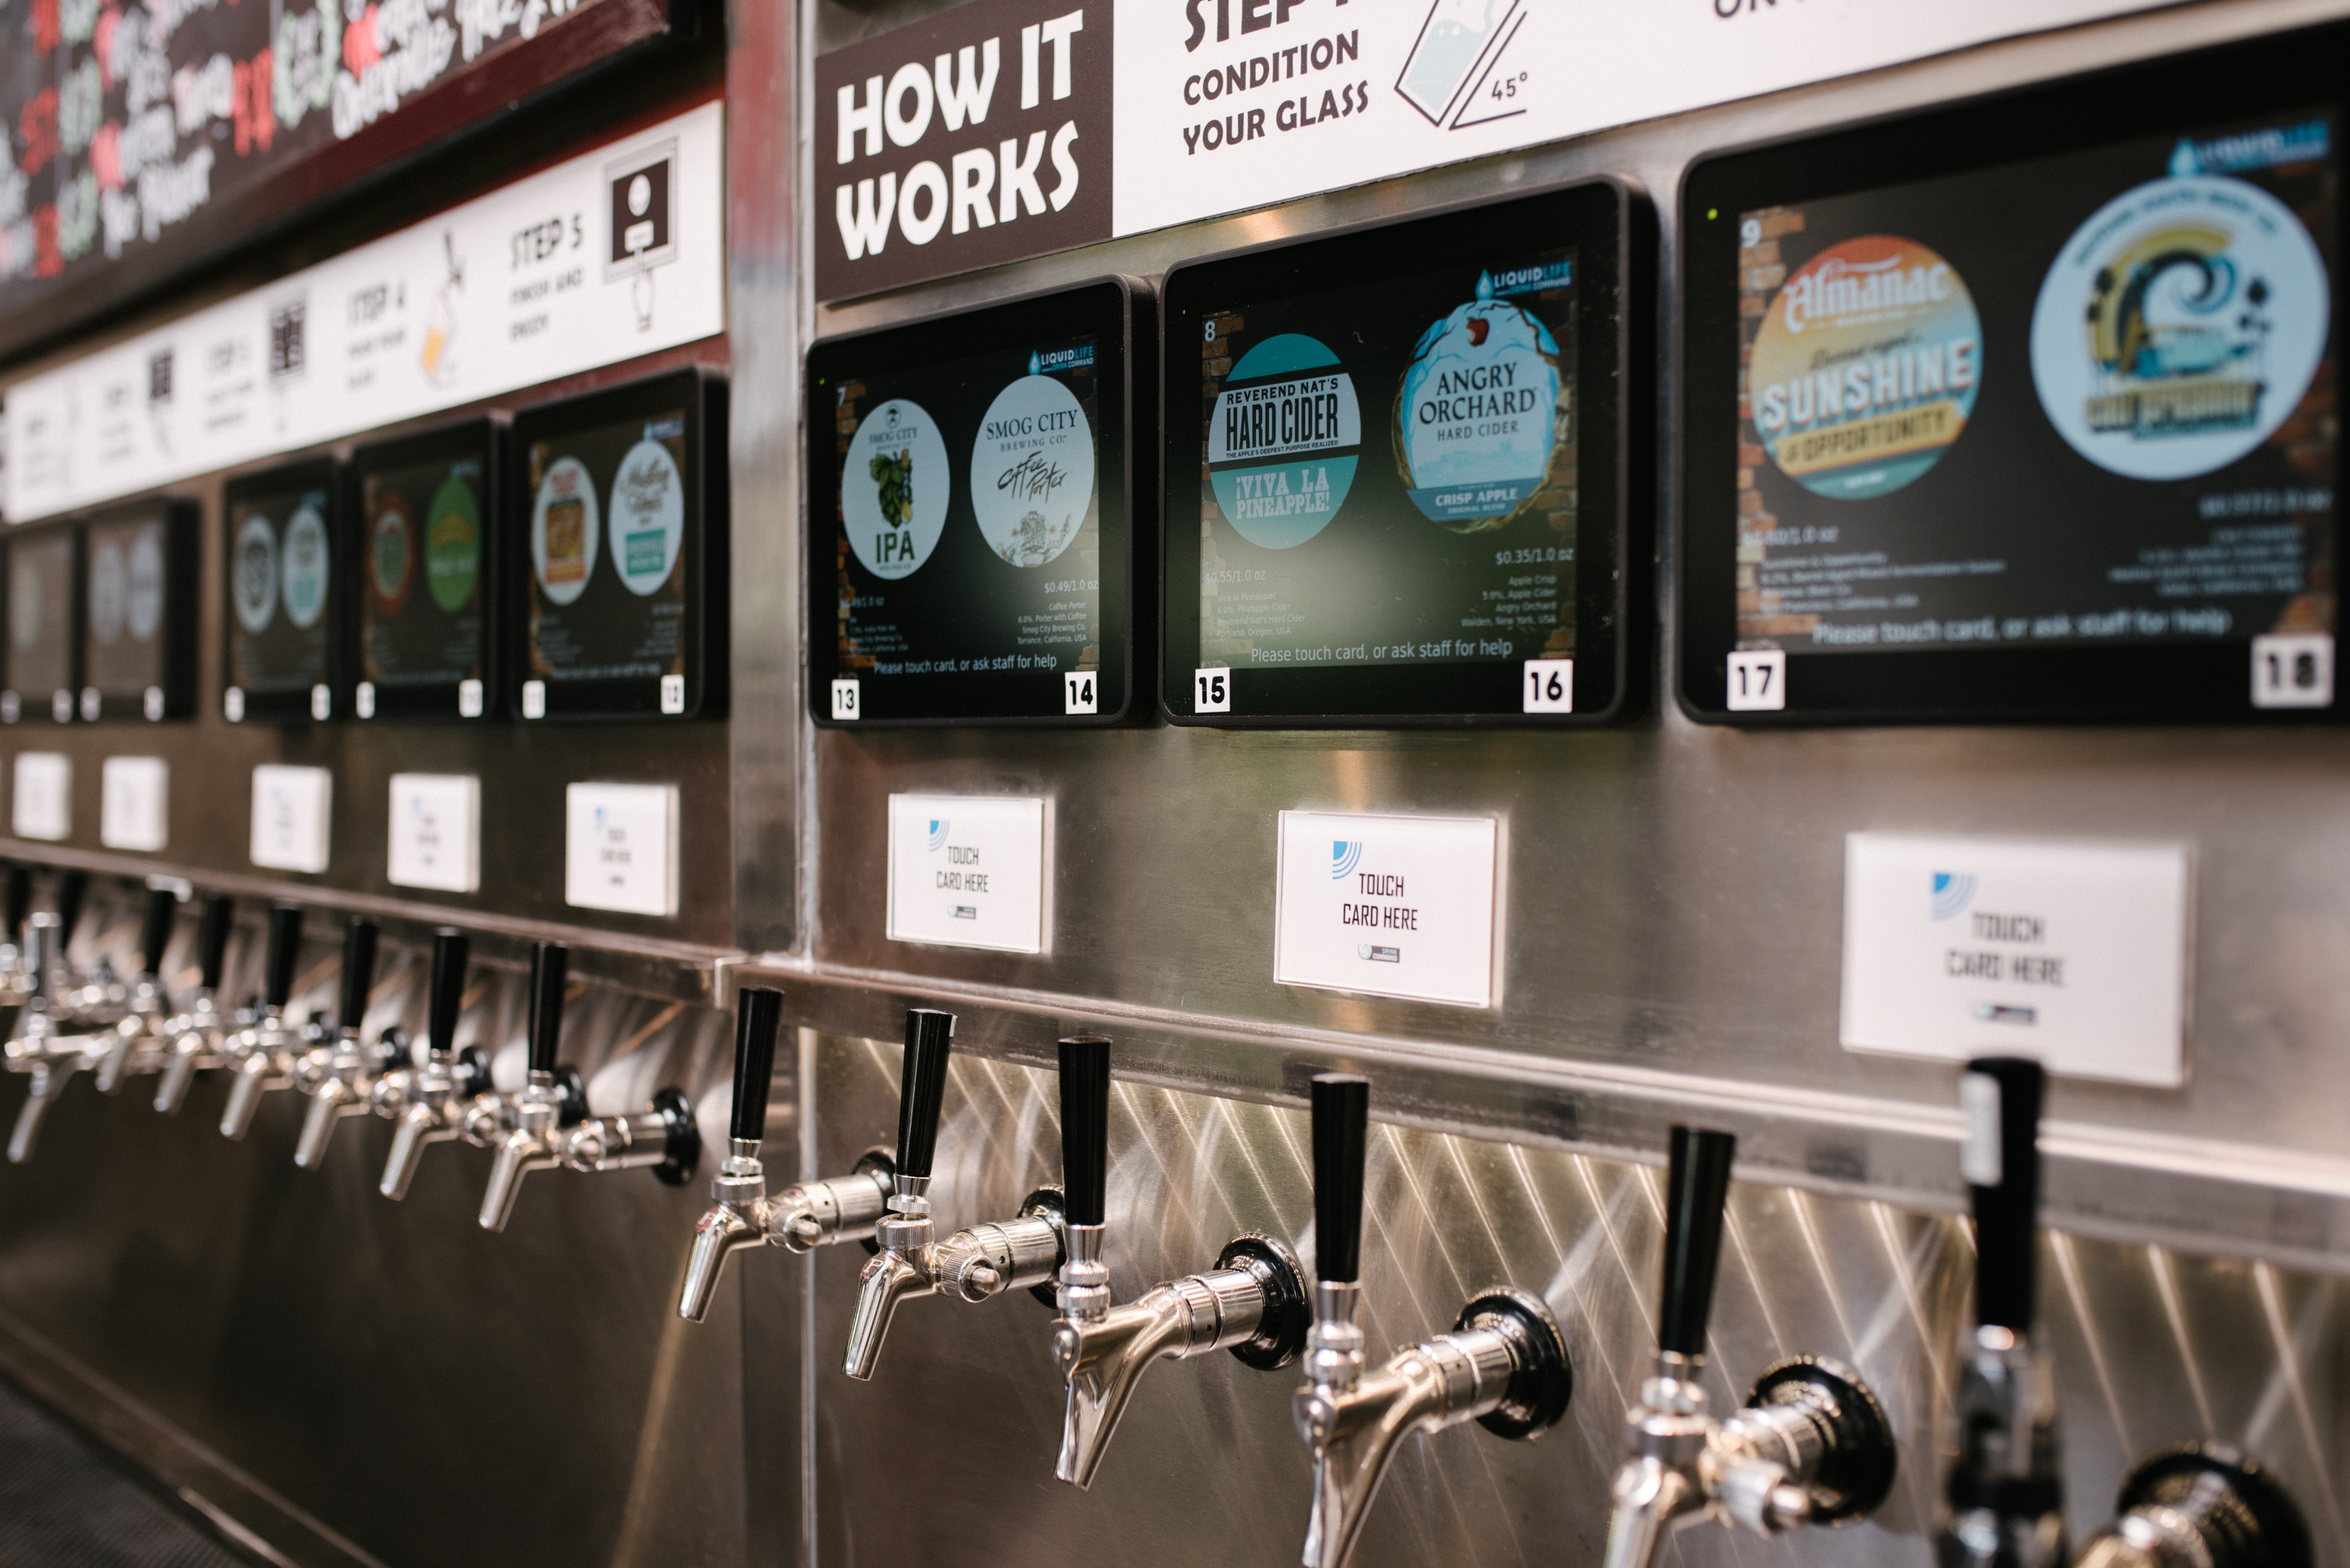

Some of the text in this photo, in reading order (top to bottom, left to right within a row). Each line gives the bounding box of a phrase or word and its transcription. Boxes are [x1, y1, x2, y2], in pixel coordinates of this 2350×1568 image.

[1184, 29, 1358, 106] CONDITION
[837, 9, 1083, 165] HOW IT
[1491, 72, 1528, 101] 45°
[1183, 80, 1369, 156] YOUR GLASS
[836, 120, 1079, 261] WORKS
[512, 213, 583, 272] STEP 5
[1741, 218, 1762, 248] 9
[1782, 253, 1950, 334] Almanac
[1205, 321, 1216, 342] 8
[1068, 357, 1094, 368] COMMAND
[1227, 378, 1339, 406] REVEREND NAT'S
[1436, 362, 1518, 396] ANGRY
[1761, 337, 1977, 432] SUNSHINE
[1419, 388, 1535, 425] ORCHARD
[986, 410, 1078, 440] SMOG CITY
[1226, 392, 1339, 451] HARD CIDER
[1437, 421, 1519, 442] HARD CIDER
[1000, 438, 1045, 452] BREWING
[1802, 408, 1949, 462] OPPORTUNITY
[1238, 450, 1260, 458] APPLE'S
[1260, 446, 1285, 455] DEEPEST
[1285, 443, 1311, 452] PURPOSE
[1311, 440, 1339, 449] REALIZED
[1301, 467, 1330, 493] LA
[1236, 491, 1330, 520] PINEAPPLE!
[1435, 492, 1473, 507] CRISP
[1476, 487, 1519, 503] APPLE
[876, 530, 915, 564] IPA
[1557, 547, 1574, 561] oz
[1044, 580, 1098, 594] $0.49/1.0 oz
[1205, 569, 1266, 584] $0.55/1.0 oz
[1048, 602, 1068, 611] Coffee
[1217, 594, 1231, 602] Viva
[1241, 591, 1276, 602] Pineapple!
[1238, 604, 1271, 613] Pineapple
[1271, 602, 1290, 611] Cider
[1022, 623, 1086, 635] Smog City Brewing Co.
[1035, 614, 1053, 623] Porter
[1068, 612, 1086, 621] Coffee
[1217, 613, 1306, 626] Reverend Nat's Hard Cider
[1043, 634, 1073, 644] California,
[1217, 627, 1292, 638] Portland, Oregon, USA
[1252, 638, 1513, 663] Please touch card, or ask staff for help
[874, 653, 1057, 675] Please touch card, or ask staff for help
[2267, 651, 2316, 688] 18
[1069, 678, 1094, 706] 14
[1198, 675, 1225, 705] 15
[1531, 670, 1563, 702] 16
[1738, 665, 1773, 696] 17
[837, 688, 855, 710] 13
[948, 846, 979, 865] TOUCH
[936, 871, 989, 893] CARD HERE
[1359, 873, 1405, 898] TOUCH
[1343, 903, 1419, 930] CARD HERE
[1972, 912, 2046, 944] TOUCH
[1372, 952, 1398, 963] COMMAND
[1381, 947, 1398, 956] DRINK
[1947, 948, 2066, 988] CARD HERE
